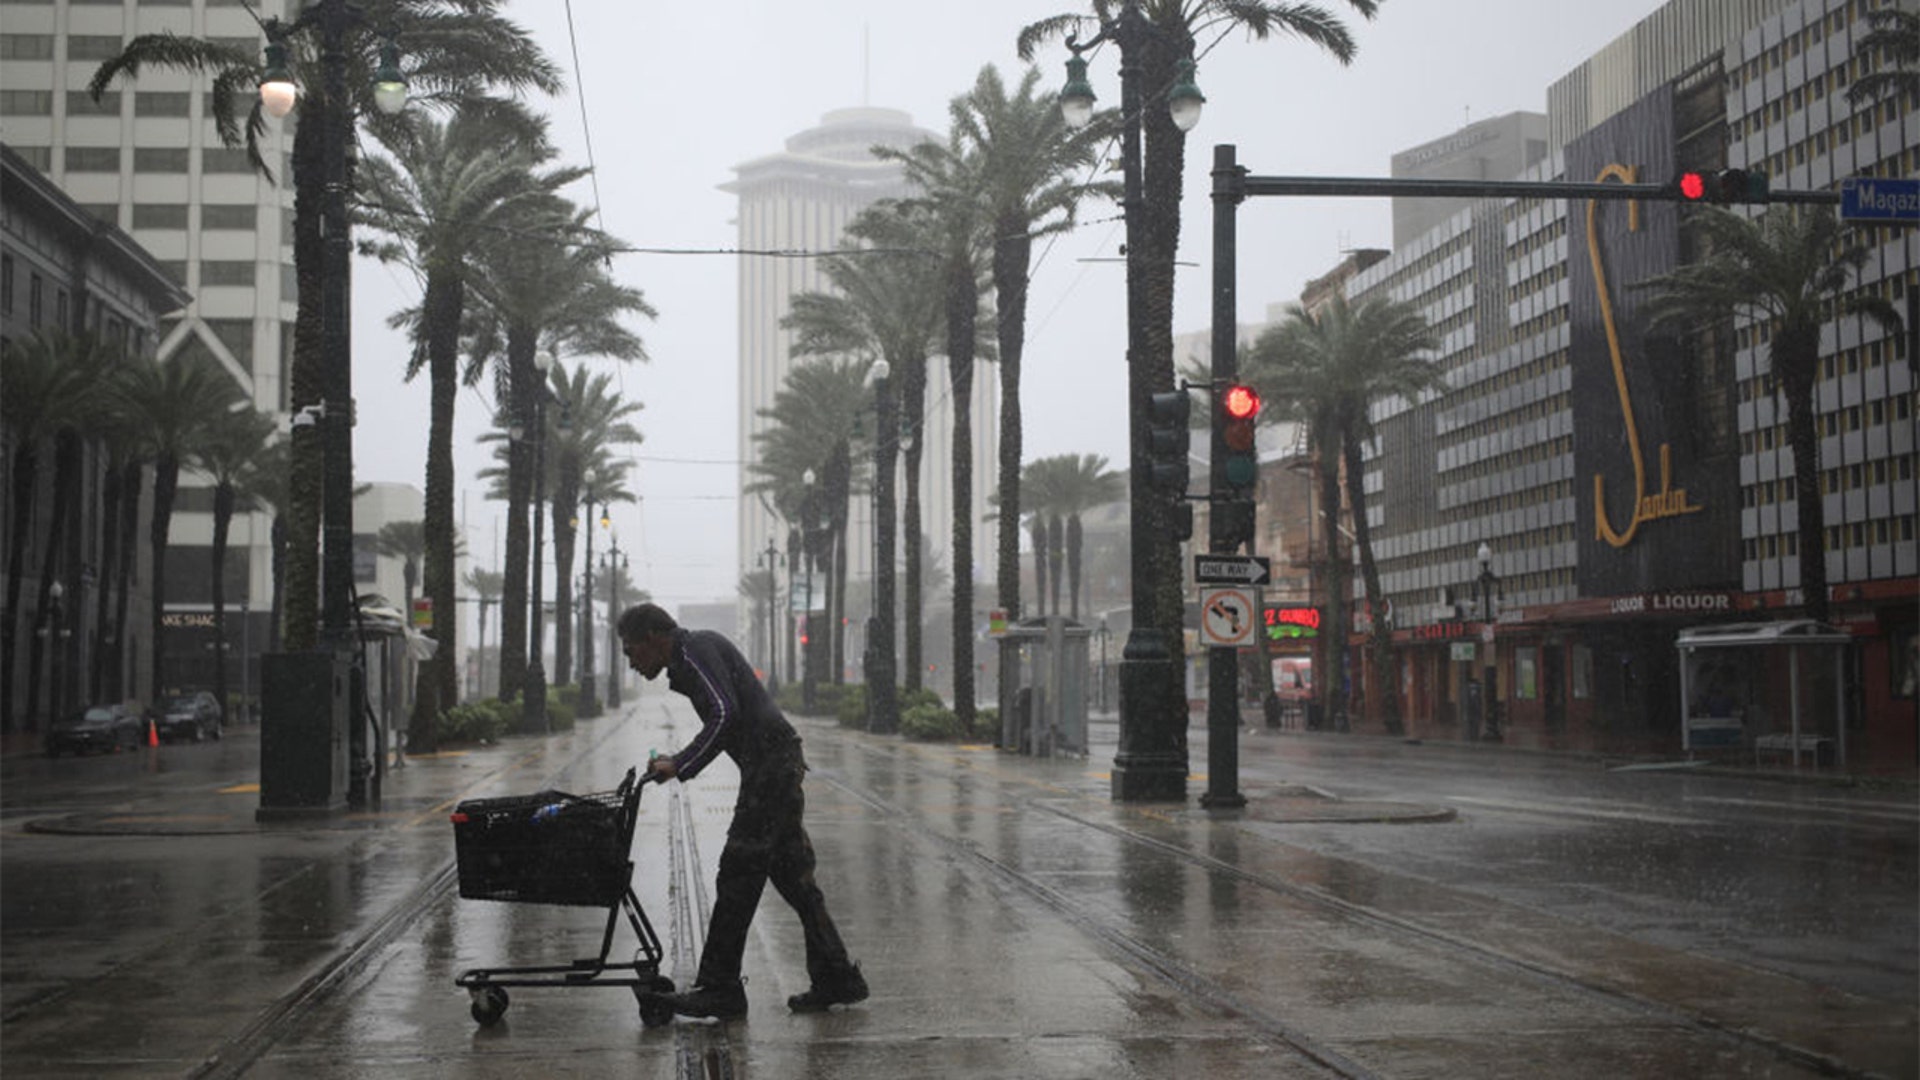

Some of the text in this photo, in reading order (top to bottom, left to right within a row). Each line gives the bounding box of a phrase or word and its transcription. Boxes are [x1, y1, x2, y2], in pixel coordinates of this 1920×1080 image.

[1202, 563, 1249, 576] ONE WAY
[1653, 594, 1729, 609] LIQUOR
